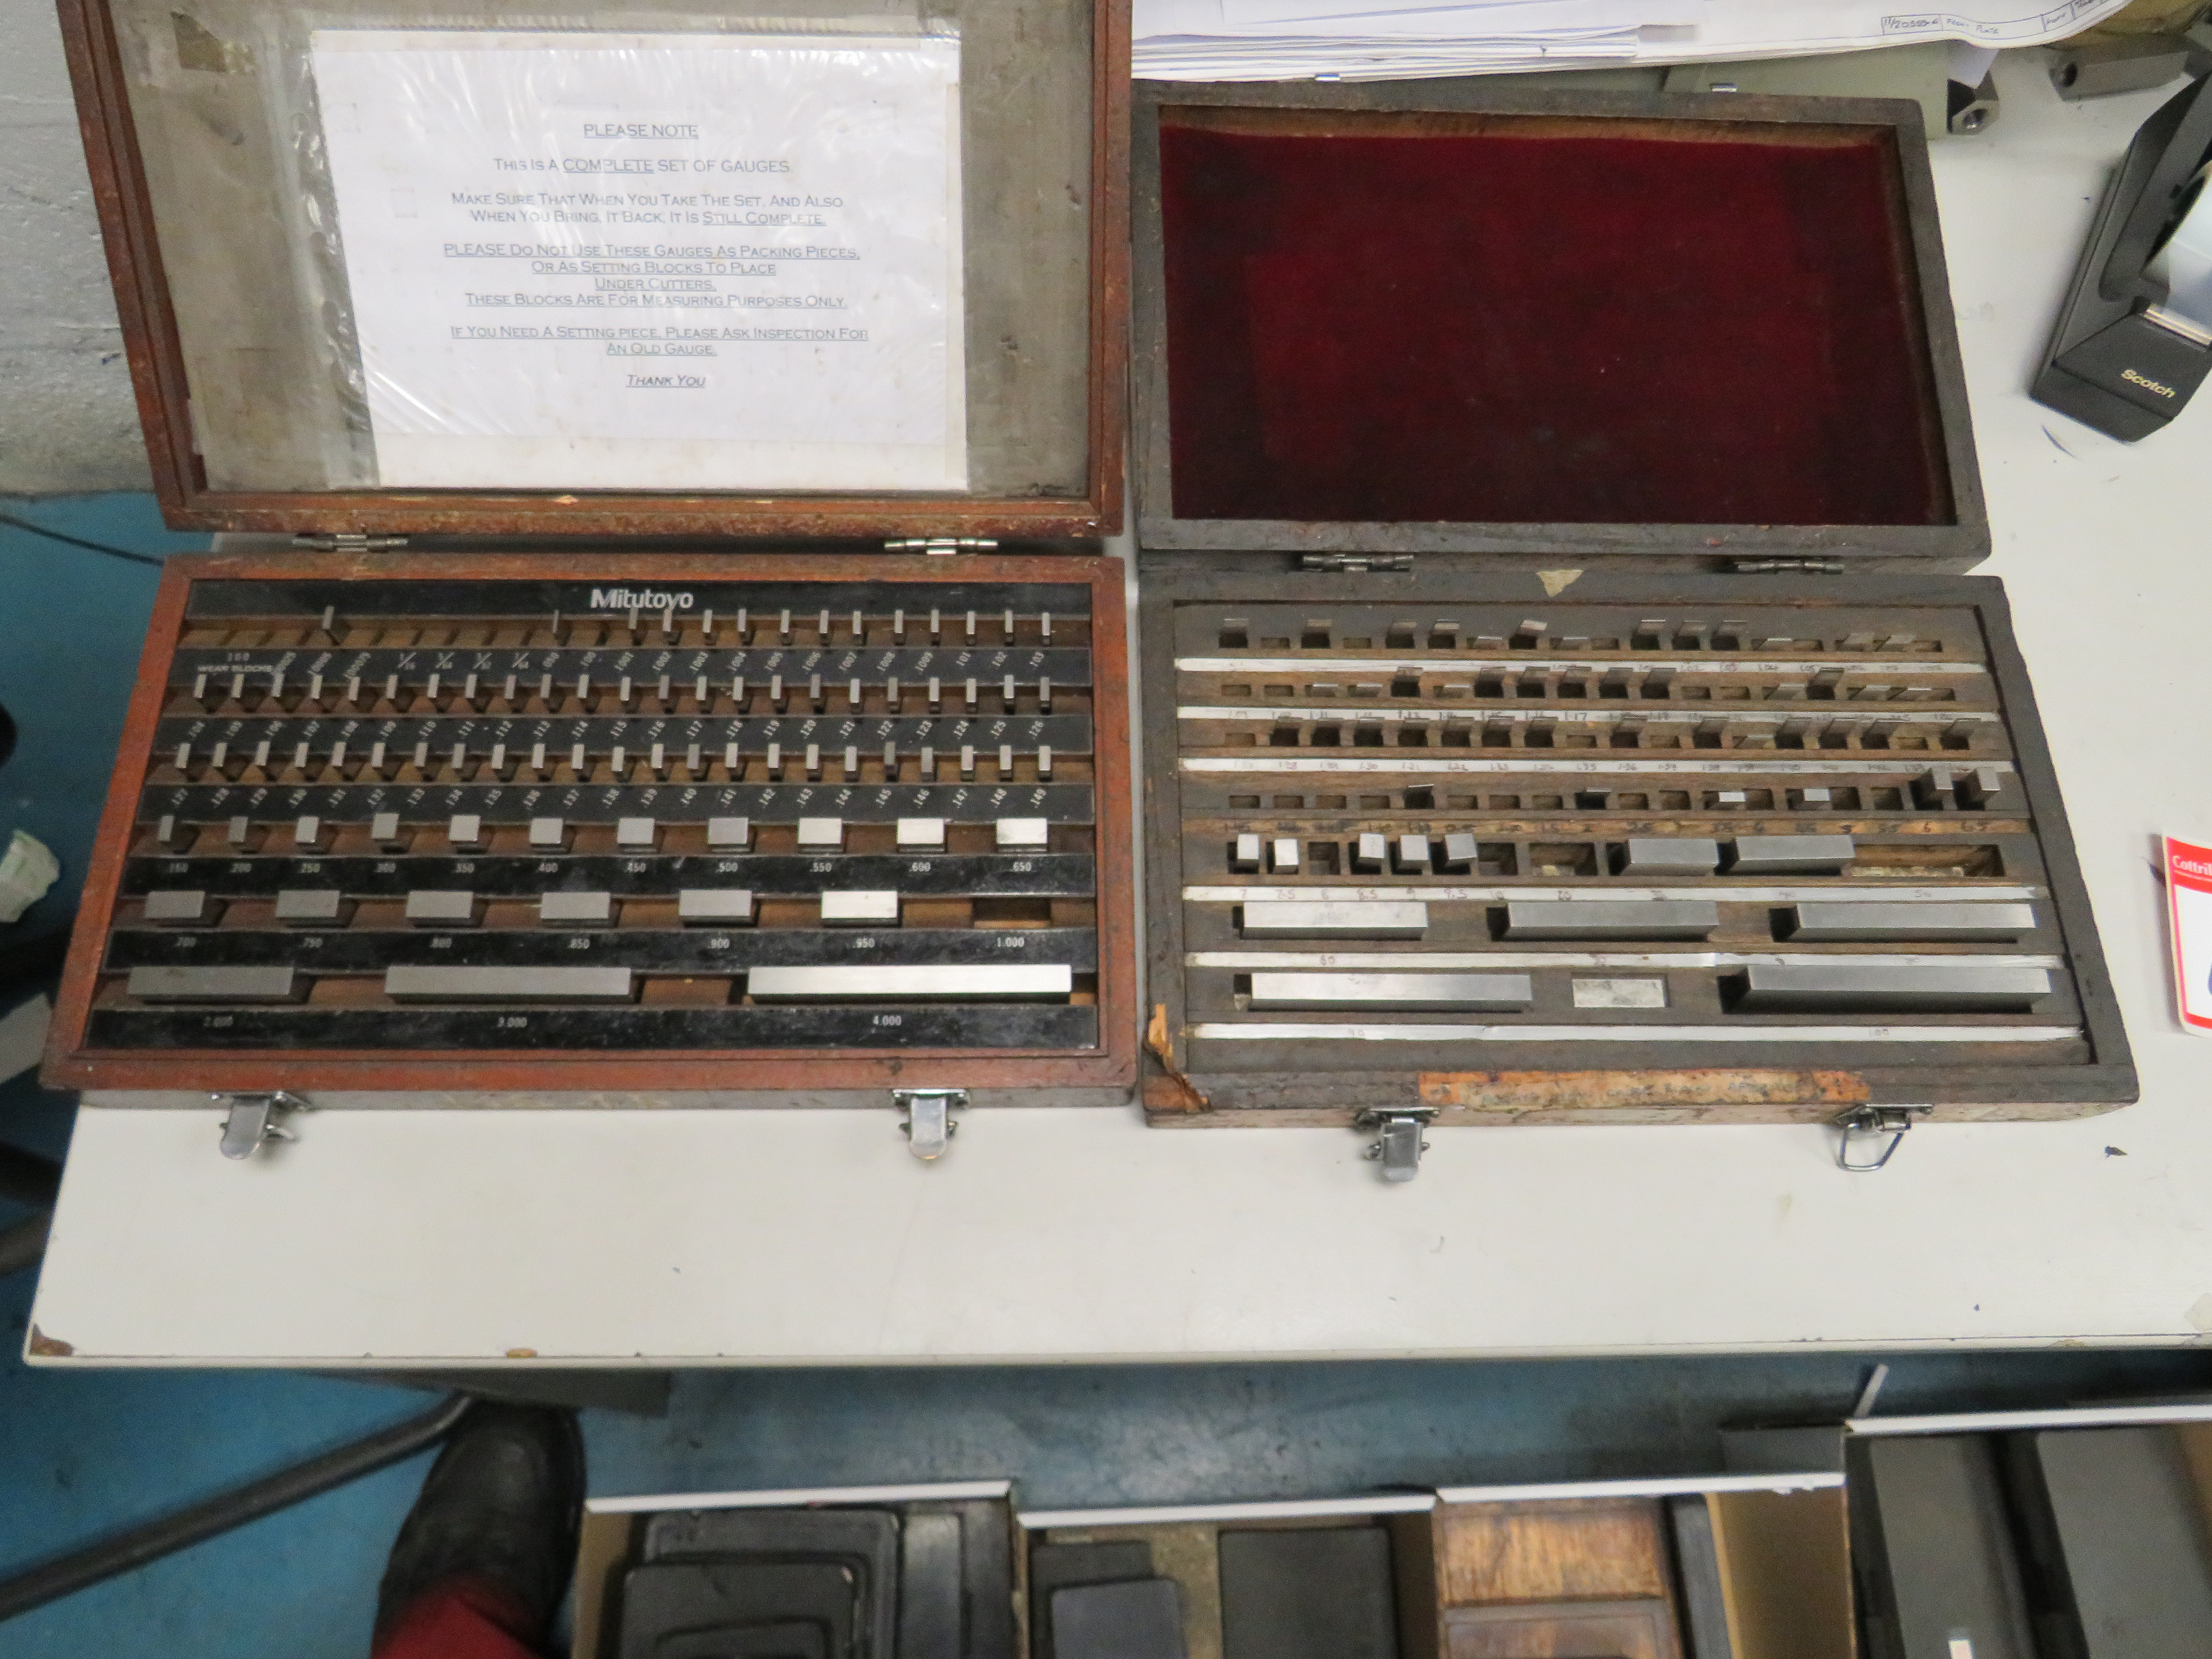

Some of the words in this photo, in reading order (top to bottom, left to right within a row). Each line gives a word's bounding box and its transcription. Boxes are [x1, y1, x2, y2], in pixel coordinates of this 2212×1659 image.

[583, 124, 647, 136] PLEASE
[653, 125, 698, 136] NOTE
[493, 158, 527, 170] THIS
[531, 159, 544, 170] IS
[549, 159, 558, 170] A
[563, 159, 652, 171] COMPLETE
[657, 159, 689, 171] SET
[693, 159, 716, 172] OF
[451, 192, 491, 204] MAKE
[496, 193, 534, 205] SURE
[538, 193, 576, 205] THAT
[579, 193, 623, 205] WHEN
[627, 194, 657, 205] YOU
[661, 194, 697, 206] TAKE
[701, 194, 729, 206] THE
[771, 195, 800, 207] AND
[805, 194, 843, 207] ALSO
[470, 209, 516, 222] WHEN
[519, 210, 550, 222] YOU
[607, 210, 619, 222] IT
[670, 211, 682, 223] IT
[686, 211, 699, 224] IS
[703, 211, 742, 224] STILL
[443, 243, 506, 256] PLEASE
[511, 244, 533, 256] DO
[537, 244, 567, 256] NOT
[573, 244, 600, 257] USE
[606, 245, 651, 257] THESE
[655, 245, 712, 258] GAUGES
[716, 245, 735, 258] AS
[740, 245, 802, 258] PACKING
[531, 260, 554, 272] OR
[559, 261, 577, 272] AS
[581, 261, 640, 273] SETTING
[644, 262, 703, 273] BLOCKS
[708, 262, 726, 274] TO
[731, 262, 775, 274] PLACE
[595, 278, 644, 290] UNDER
[465, 293, 510, 305] THESE
[514, 293, 572, 305] BLOCKS
[577, 293, 604, 305] ARE
[609, 293, 638, 305] FOR
[643, 294, 723, 306] MEASURING
[727, 294, 802, 306] PURPOSES
[451, 326, 464, 337] IF
[468, 326, 497, 337] YOU
[500, 326, 539, 337] NEED
[544, 327, 553, 337] A
[556, 327, 615, 338] SETTING
[665, 327, 718, 339] PLEASE
[722, 328, 749, 339] ASK
[754, 328, 836, 340] INSPECTION
[840, 328, 869, 339] FOR
[607, 343, 627, 354] AN
[631, 343, 661, 354] OLD
[628, 375, 673, 386] THANK
[678, 375, 706, 386] YOU
[2121, 369, 2176, 398] Scotch
[590, 588, 694, 610] Mitutoyo
